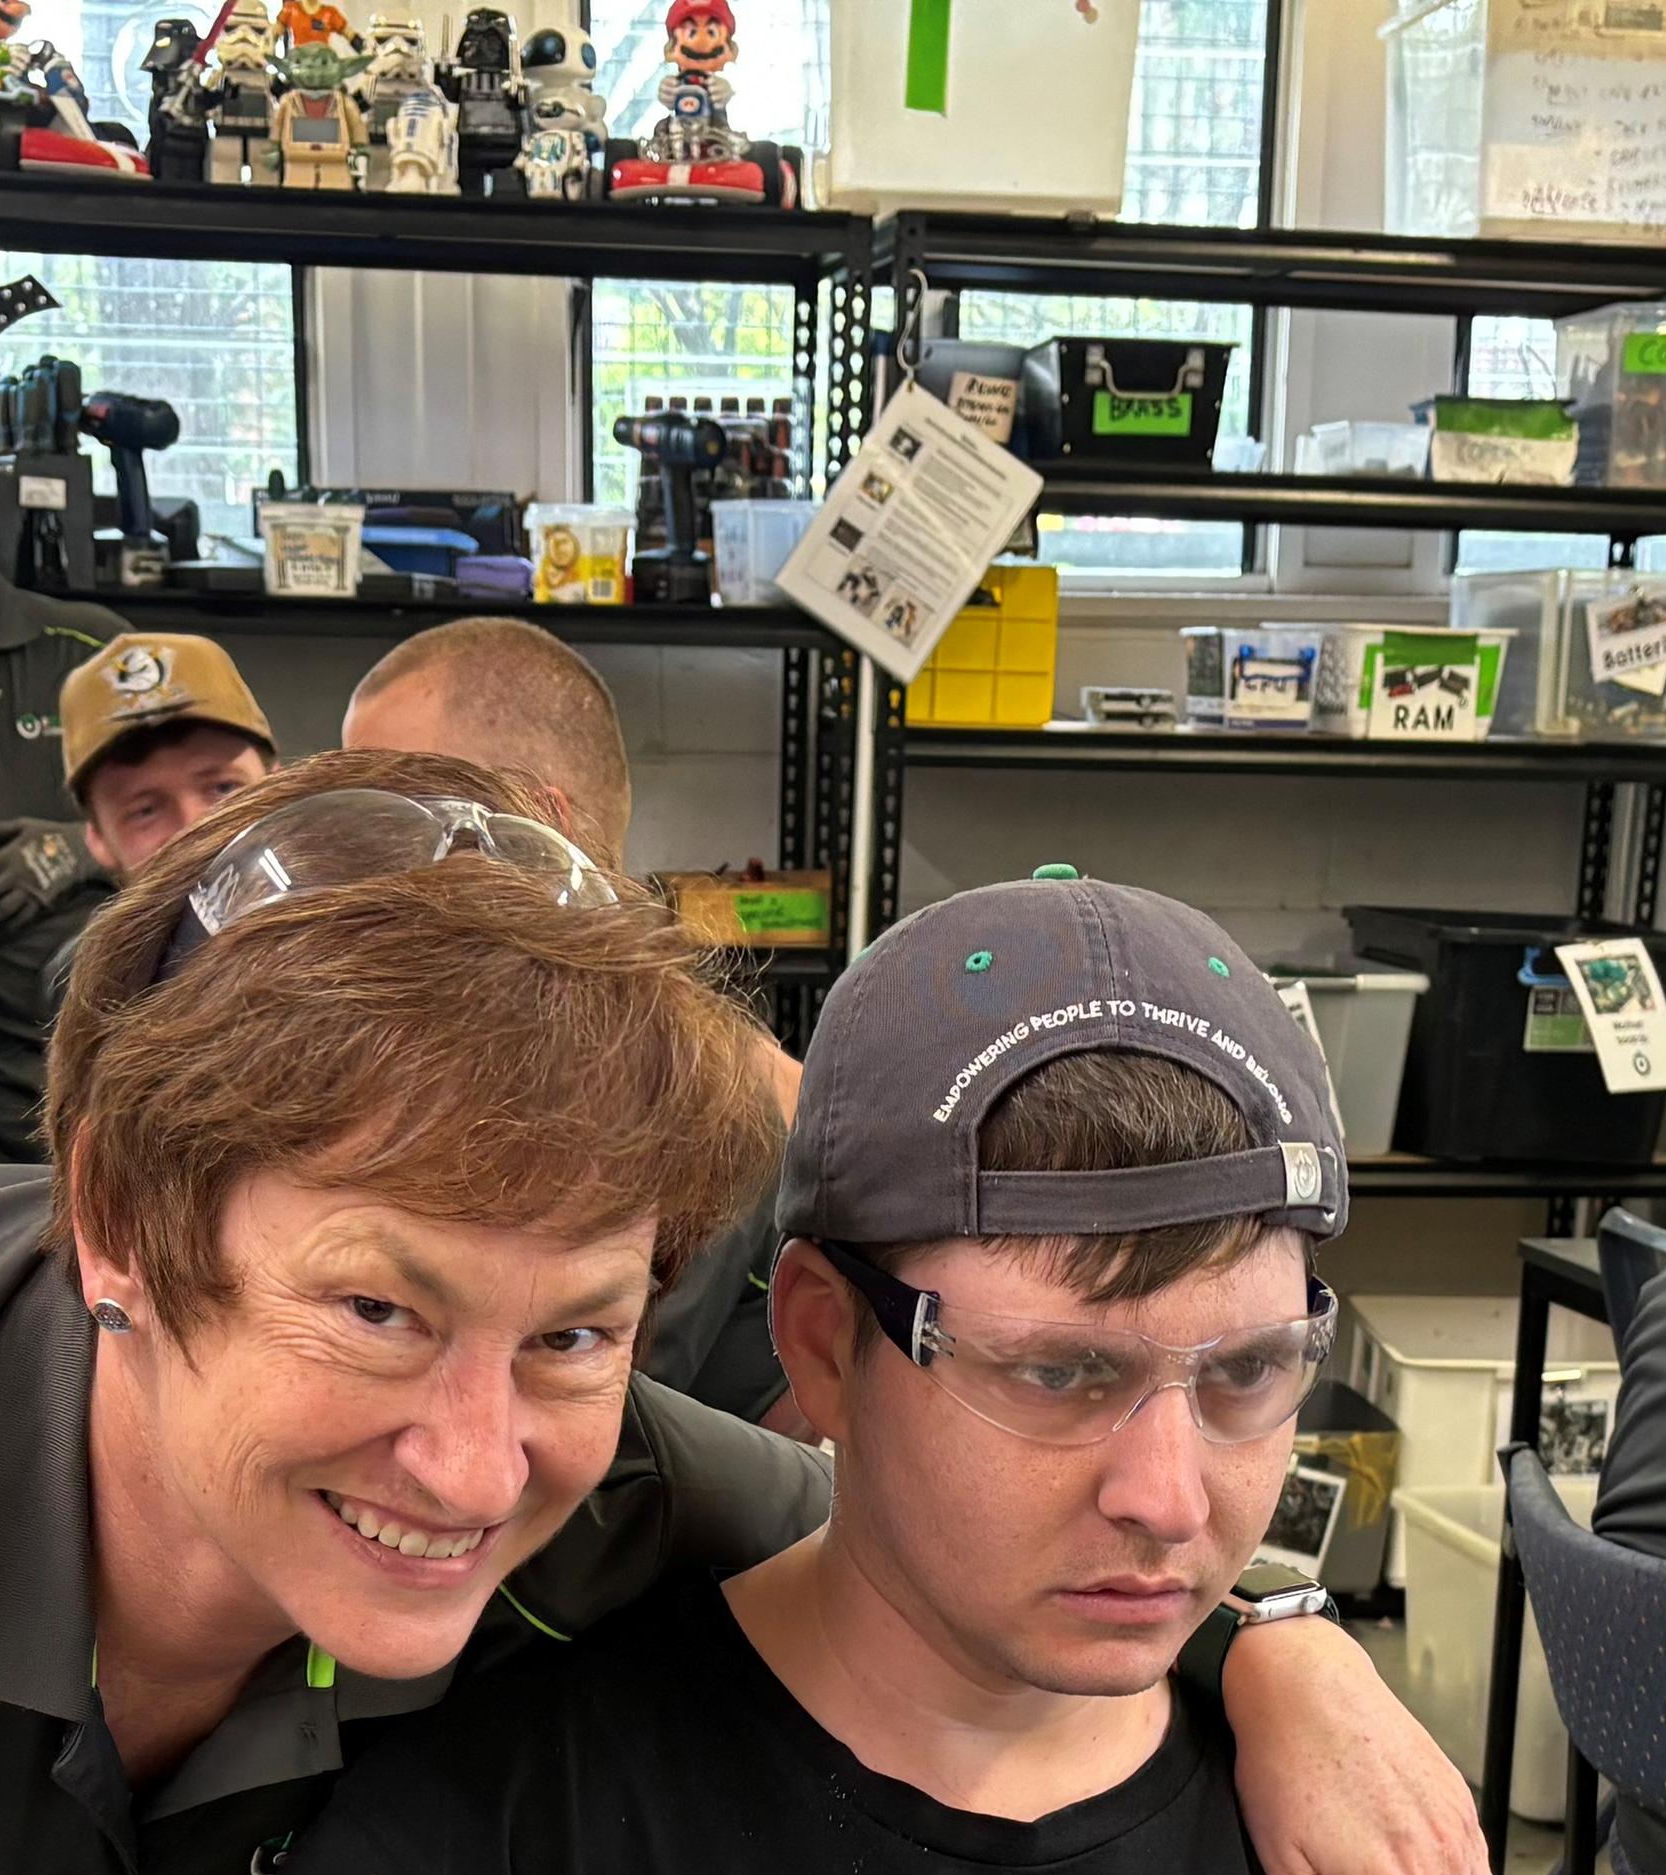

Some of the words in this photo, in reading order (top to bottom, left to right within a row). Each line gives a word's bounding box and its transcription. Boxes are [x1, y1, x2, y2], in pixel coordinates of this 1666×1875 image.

[1393, 704, 1454, 731] RAM
[932, 1021, 1030, 1124] EMPOWERING
[1029, 1000, 1103, 1032] PEOPLE
[1110, 999, 1137, 1017] TO
[1141, 1001, 1211, 1039] THRIVE
[1210, 1028, 1247, 1062] AND
[1245, 1054, 1295, 1125] BELONG
